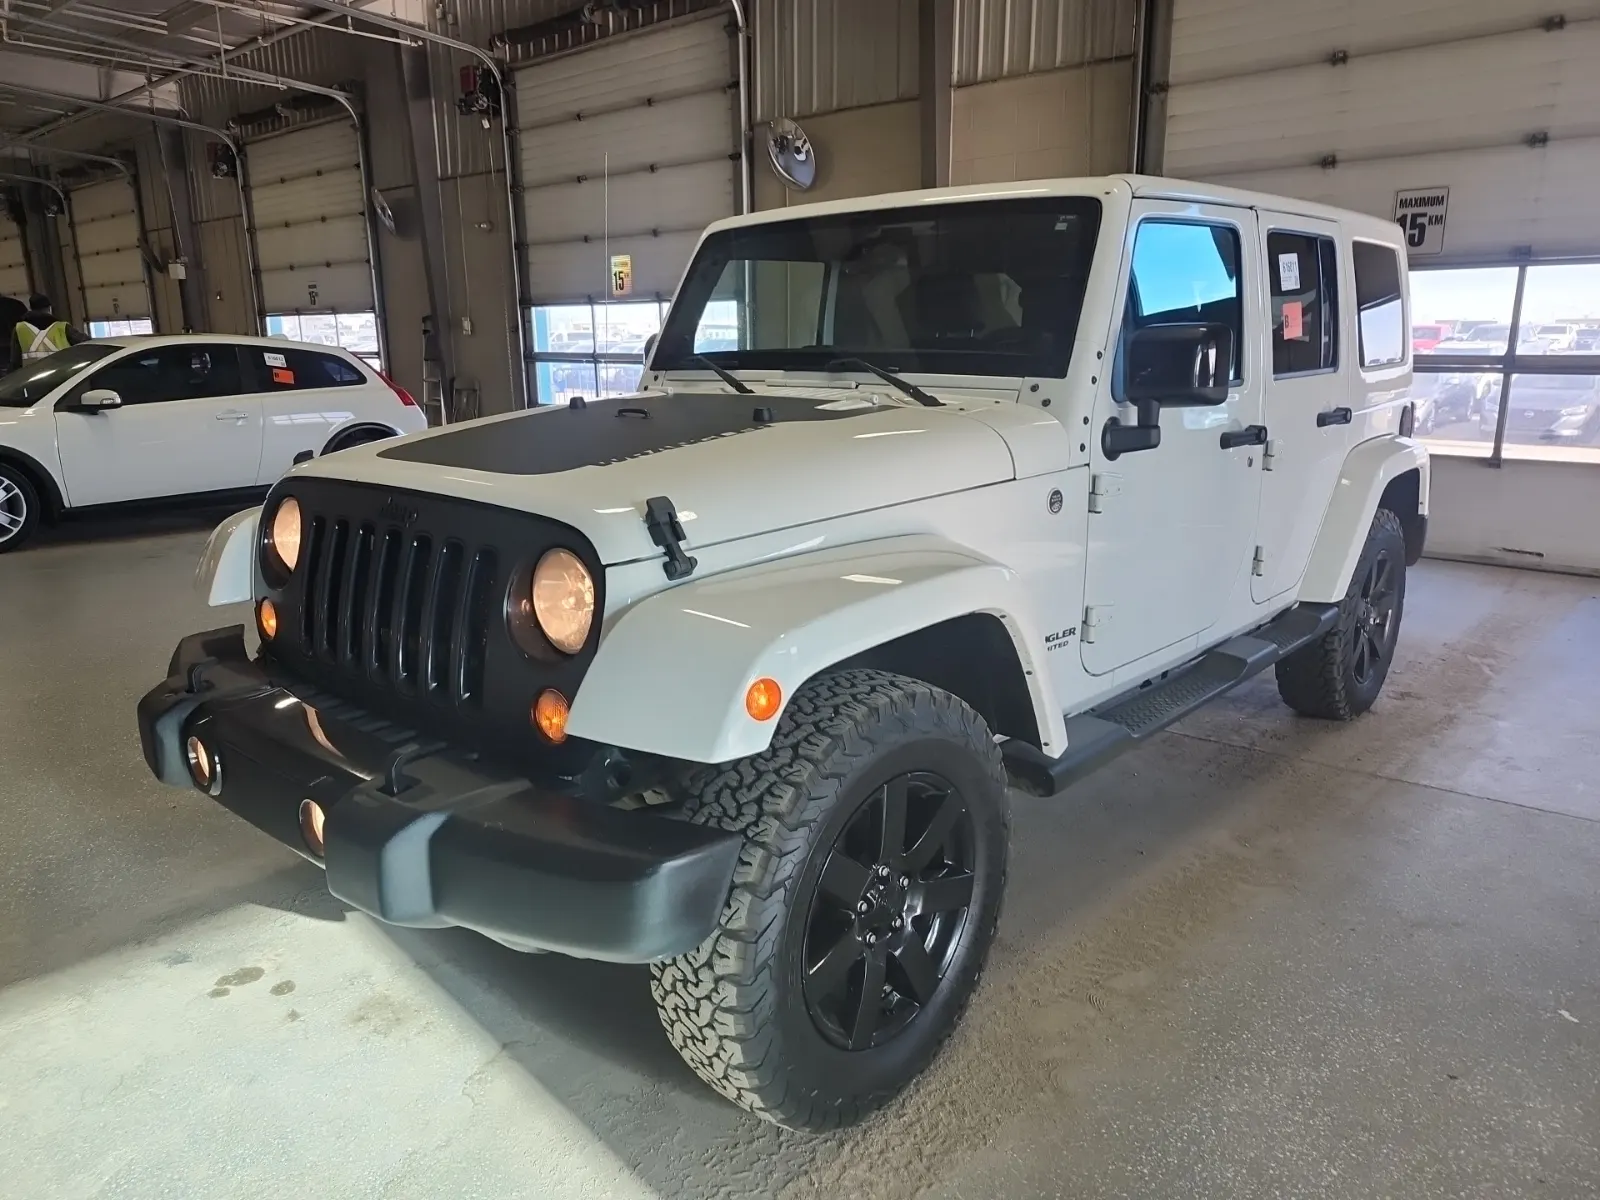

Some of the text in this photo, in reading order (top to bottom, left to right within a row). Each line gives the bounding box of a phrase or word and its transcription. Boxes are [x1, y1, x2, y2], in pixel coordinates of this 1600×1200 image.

[1399, 195, 1445, 208] MAXIMUM
[1428, 214, 1443, 226] KM
[613, 271, 624, 291] 15
[1284, 315, 1290, 329] B
